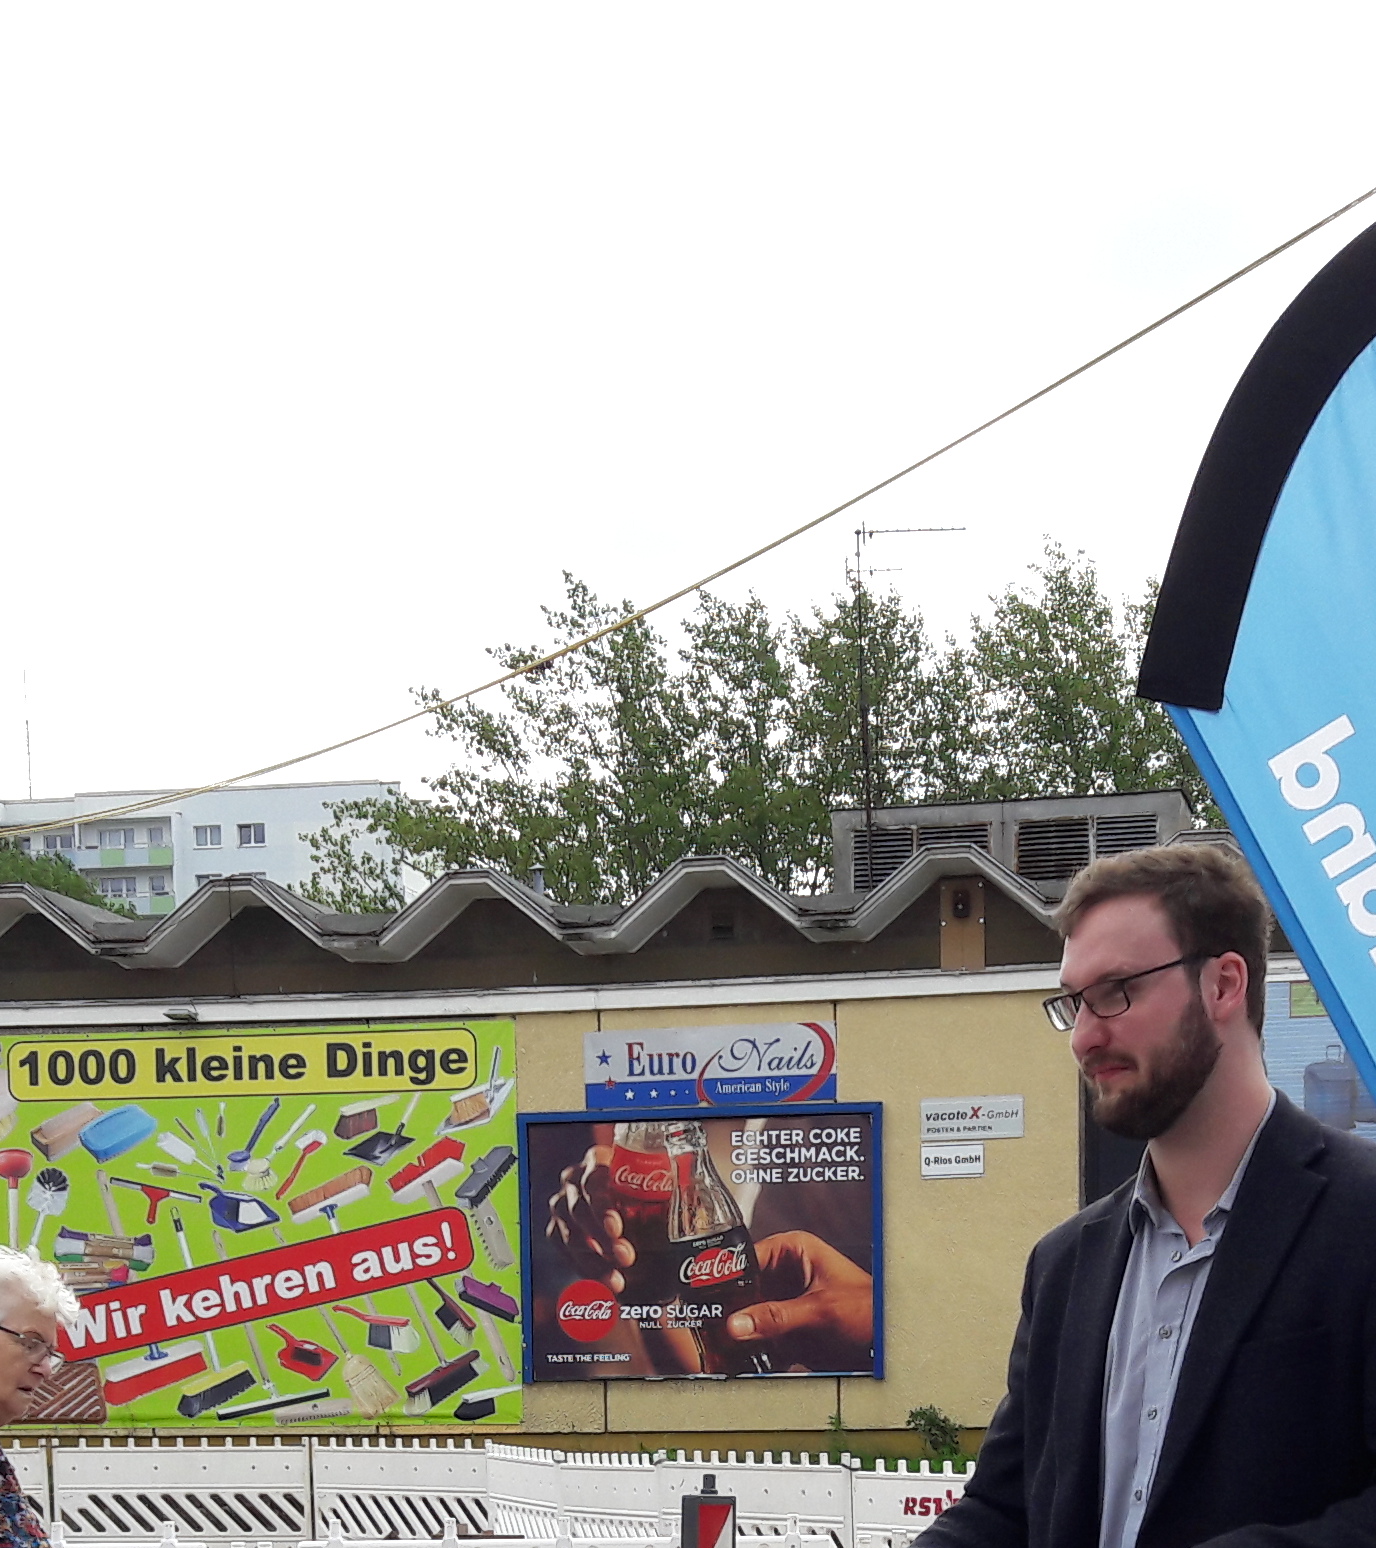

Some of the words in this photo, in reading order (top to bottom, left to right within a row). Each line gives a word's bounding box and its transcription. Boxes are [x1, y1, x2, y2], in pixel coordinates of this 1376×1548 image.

[20, 1049, 135, 1086] 1000
[155, 1045, 307, 1083] kleine
[326, 1039, 468, 1084] Dinge
[625, 1042, 697, 1077] Euro
[718, 1037, 817, 1073] Nails
[715, 1081, 762, 1095] American
[765, 1078, 790, 1095] Style
[731, 1129, 803, 1146] ECHTER
[809, 1127, 861, 1143] COKE
[731, 1146, 865, 1165] GESCHMACK.
[731, 1169, 783, 1184] OHNE
[787, 1166, 865, 1183] ZUCKER.
[64, 1299, 147, 1351] Wir
[159, 1260, 336, 1328] kehren
[350, 1221, 457, 1282] aus!
[559, 1300, 614, 1320] Coca-Cola
[620, 1305, 662, 1319] zero
[666, 1304, 723, 1318] SUGAR
[639, 1321, 663, 1329] NULL
[666, 1320, 703, 1328] ZUCKER
[546, 1354, 574, 1362] TASTE
[575, 1354, 592, 1362] THE
[593, 1353, 630, 1362] FEELING
